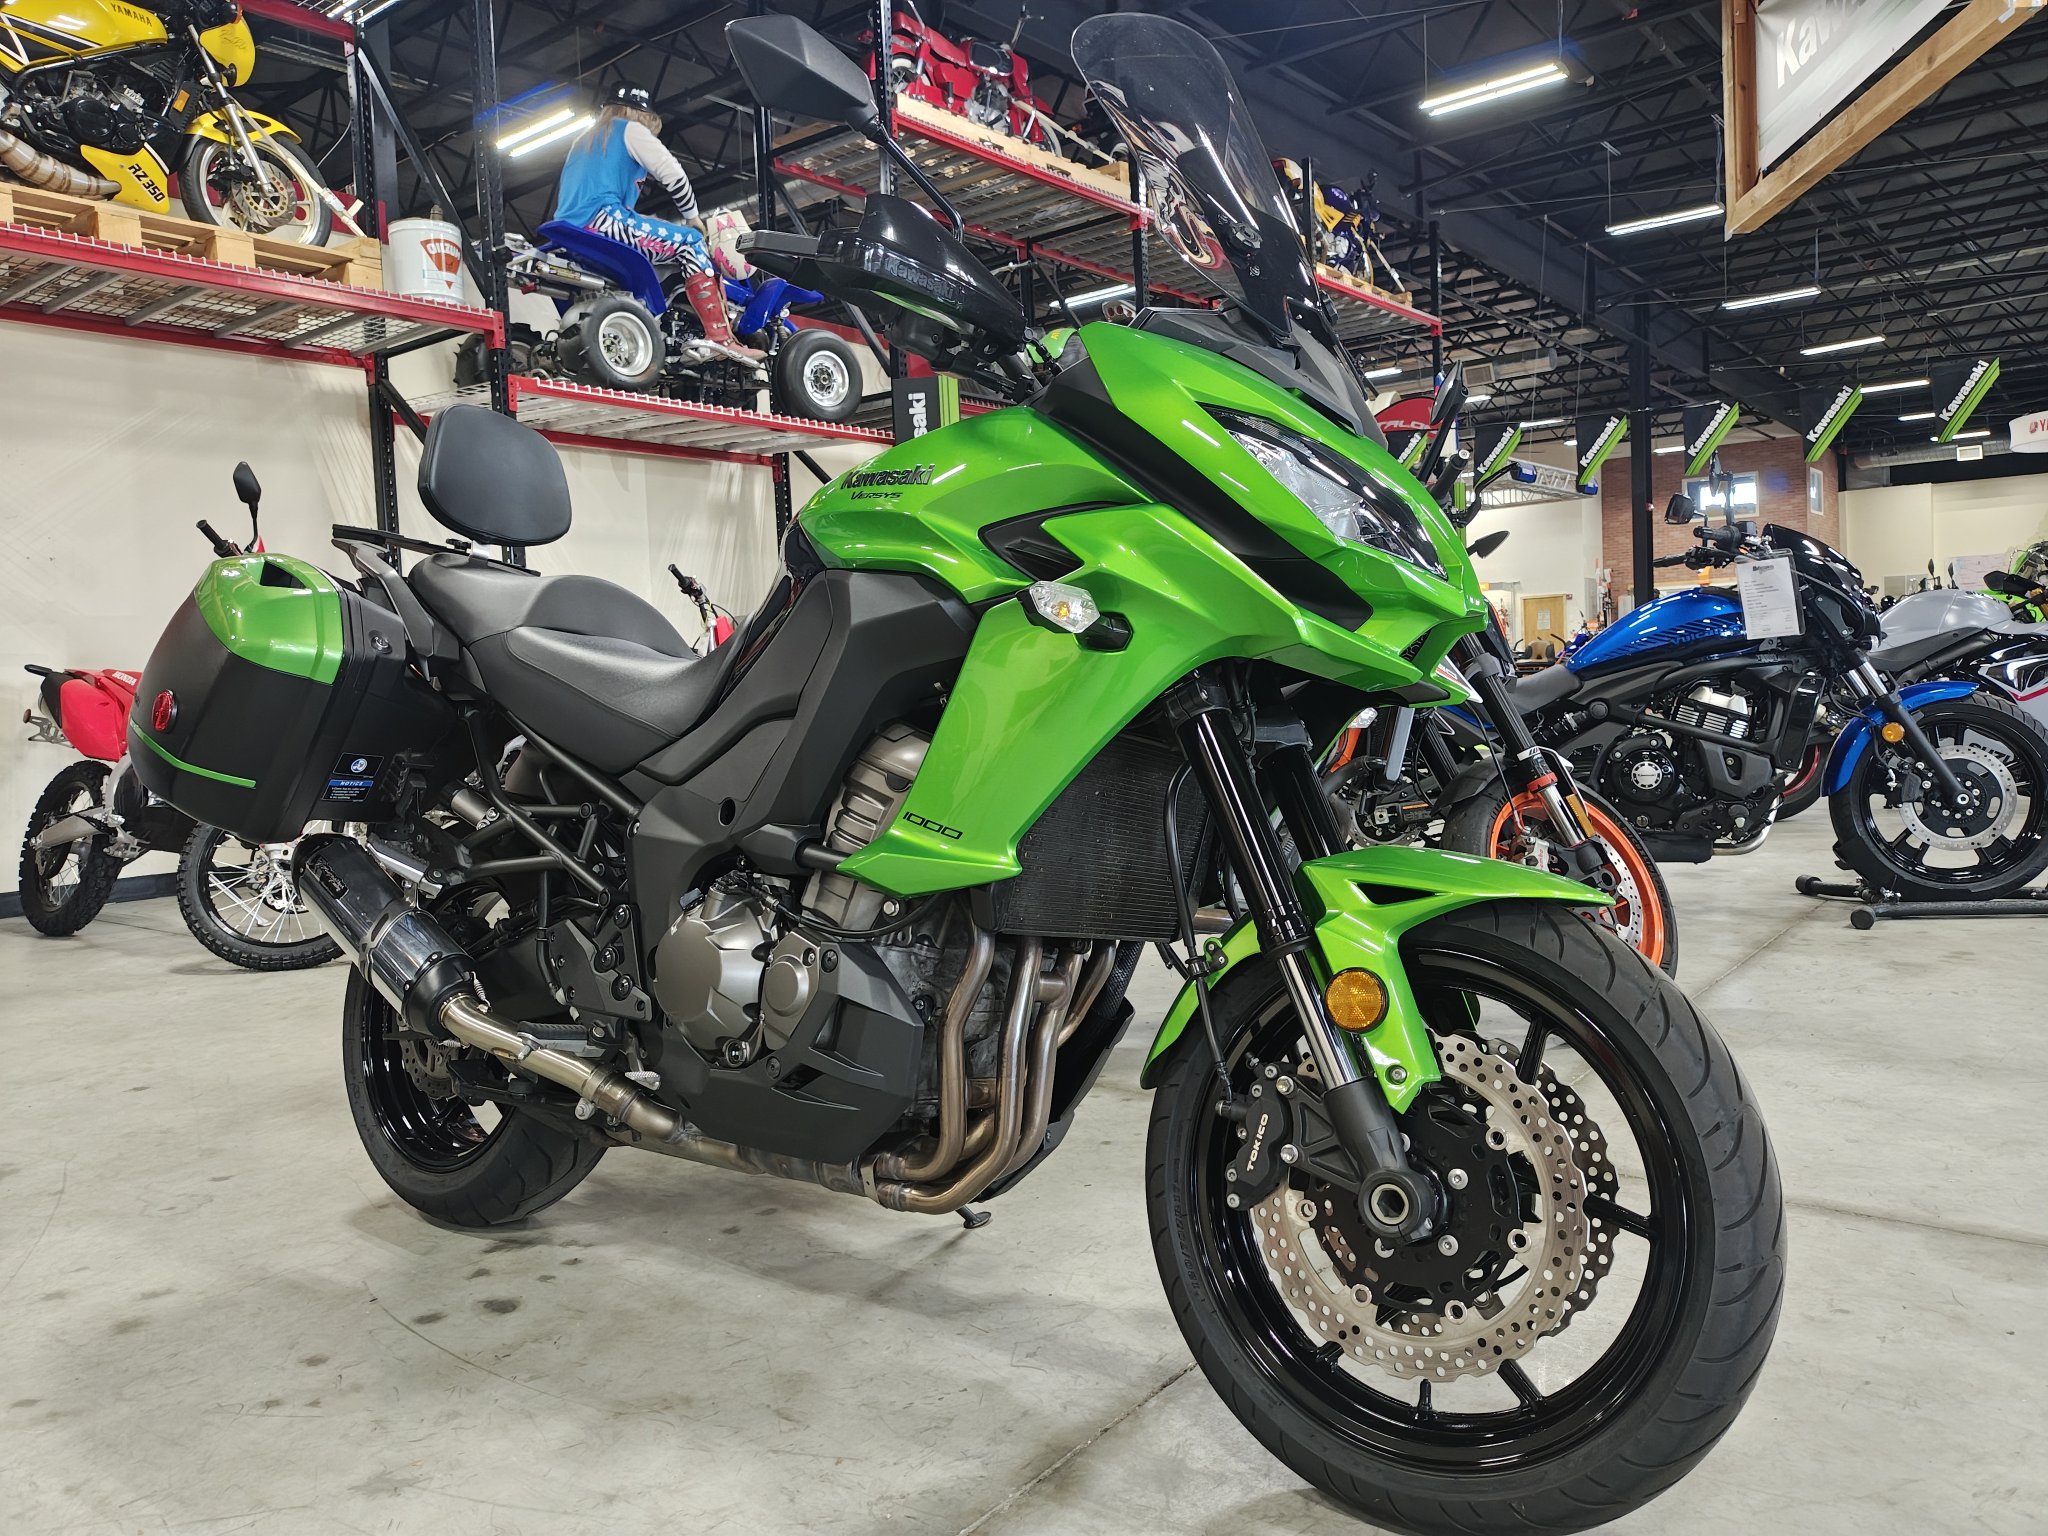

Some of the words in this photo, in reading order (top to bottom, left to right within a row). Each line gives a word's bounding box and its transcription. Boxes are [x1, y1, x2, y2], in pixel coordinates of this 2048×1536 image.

[111, 2, 153, 27] YAMAHA
[128, 163, 149, 182] RZ
[142, 179, 166, 203] 350
[884, 256, 954, 300] Kawasaki
[1805, 384, 1853, 443] Kawasaki
[1938, 359, 1990, 422] Kawasaki
[908, 392, 928, 439] saki
[1687, 402, 1731, 457] Kawasaki
[1476, 426, 1515, 474] Kawasaki
[1579, 415, 1620, 468] Kawasaki
[840, 463, 936, 490] Kawasaki
[850, 490, 903, 500] VERSYS
[902, 811, 964, 840] 1000
[1246, 1113, 1269, 1172] TOKICO
